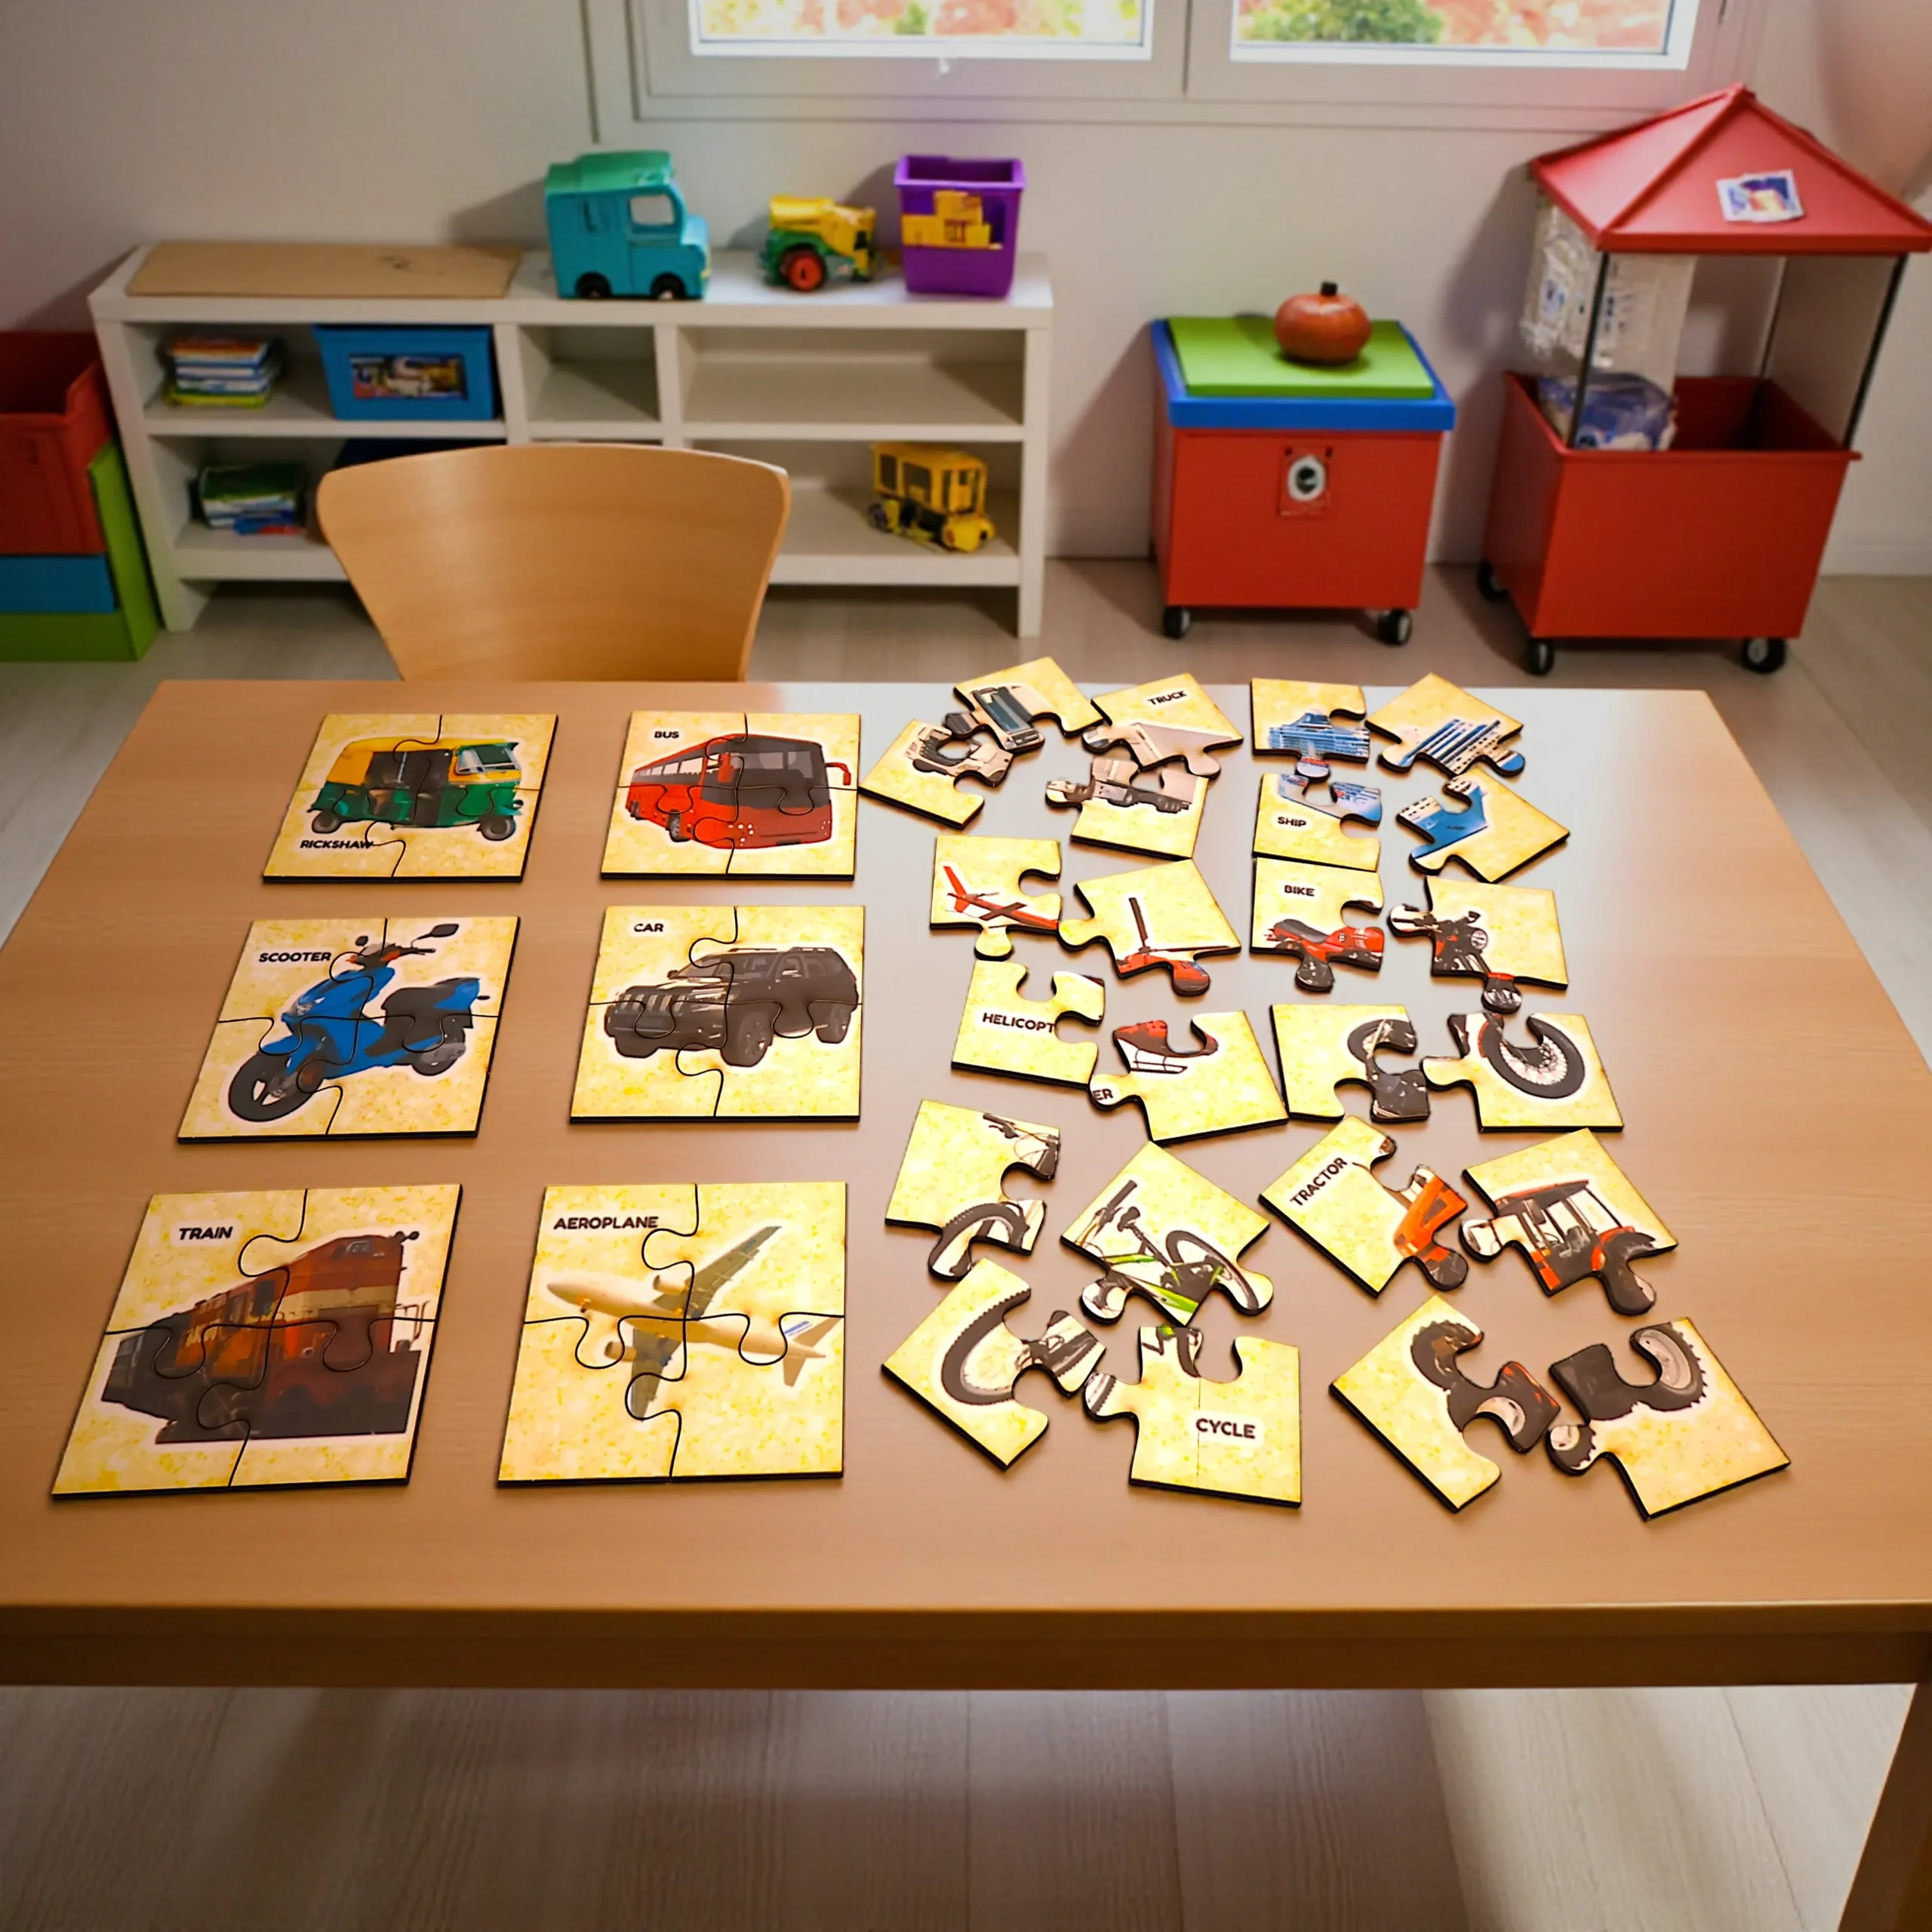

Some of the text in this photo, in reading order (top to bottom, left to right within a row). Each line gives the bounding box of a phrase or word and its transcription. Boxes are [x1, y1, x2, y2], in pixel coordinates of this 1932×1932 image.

[1148, 691, 1187, 705] TRUCK
[654, 730, 680, 740] BUS
[1277, 816, 1307, 827] SHIP
[300, 838, 371, 850] RICKSHAW
[1284, 885, 1315, 897] BIKE
[633, 922, 664, 933] CAR
[258, 952, 332, 963] SCOOTER
[1290, 1157, 1349, 1206] TRACTOR
[553, 1216, 659, 1230] AEROPLANE
[179, 1226, 234, 1241] TRAIN
[1195, 1418, 1257, 1439] CYCLE
